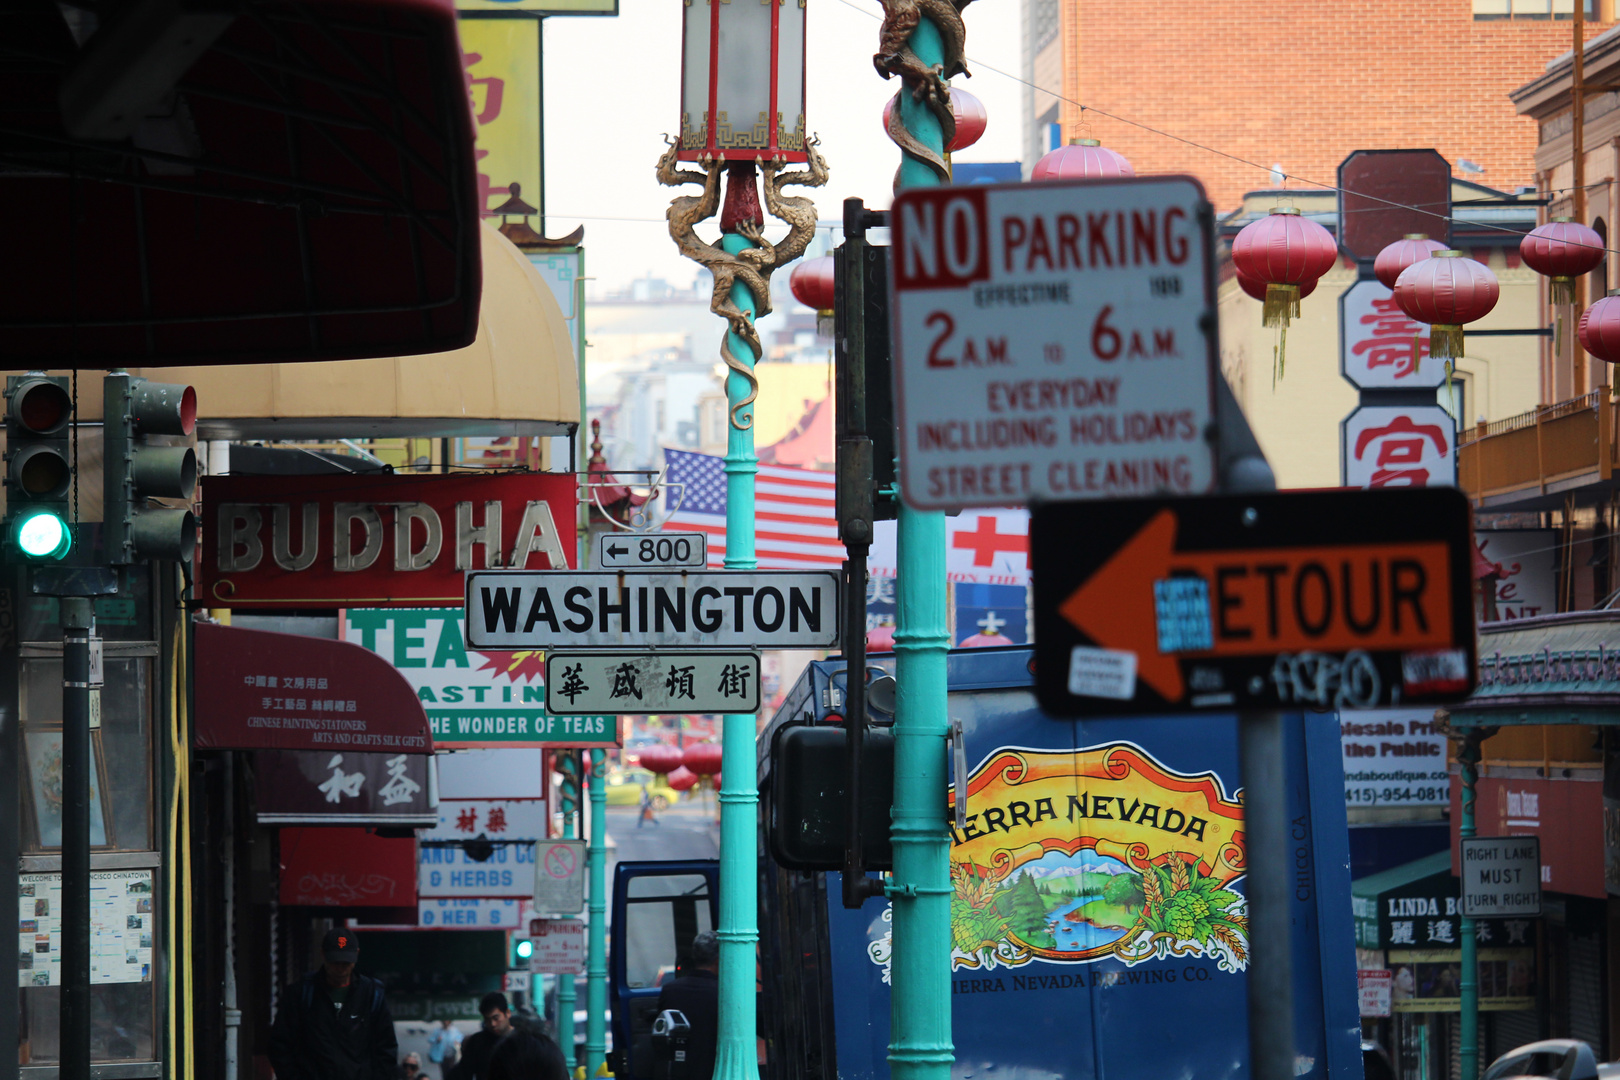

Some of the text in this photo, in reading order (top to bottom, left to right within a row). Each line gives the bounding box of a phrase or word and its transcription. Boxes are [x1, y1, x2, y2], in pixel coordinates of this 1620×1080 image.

[903, 197, 1190, 280] NO PARKING
[986, 377, 1121, 413] EVERYDAY
[917, 410, 1197, 450] INCLUDING HOLIDAYS
[926, 454, 1193, 497] STREET CLEANING
[217, 500, 570, 571] BUDDHA
[638, 538, 691, 562] 800
[480, 586, 821, 633] WASHINGTON
[1168, 557, 1430, 640] ETOUR
[351, 619, 470, 668] TEA
[556, 662, 750, 705] 華盛頓街
[247, 716, 282, 728] CHINESE
[282, 717, 320, 730] PAINTING
[430, 717, 605, 734] HE WONDER OF TEAS
[1341, 721, 1404, 736] lesale
[312, 732, 426, 747] ARTS AND CRAFTS SILK GIFTS
[1345, 741, 1441, 757] the Public
[949, 791, 1208, 847] IERRA NEVADA
[1466, 847, 1535, 861] RIGHT LANE
[22, 874, 52, 882] WELCOME
[450, 870, 513, 887] HERBS
[1480, 869, 1522, 884] MUST
[1388, 897, 1440, 917] LINDA
[1467, 893, 1537, 906] TURN RIGHT
[953, 978, 1005, 995] IERRA
[1013, 974, 1085, 992] NEVADA
[1090, 967, 1177, 988] BREWING
